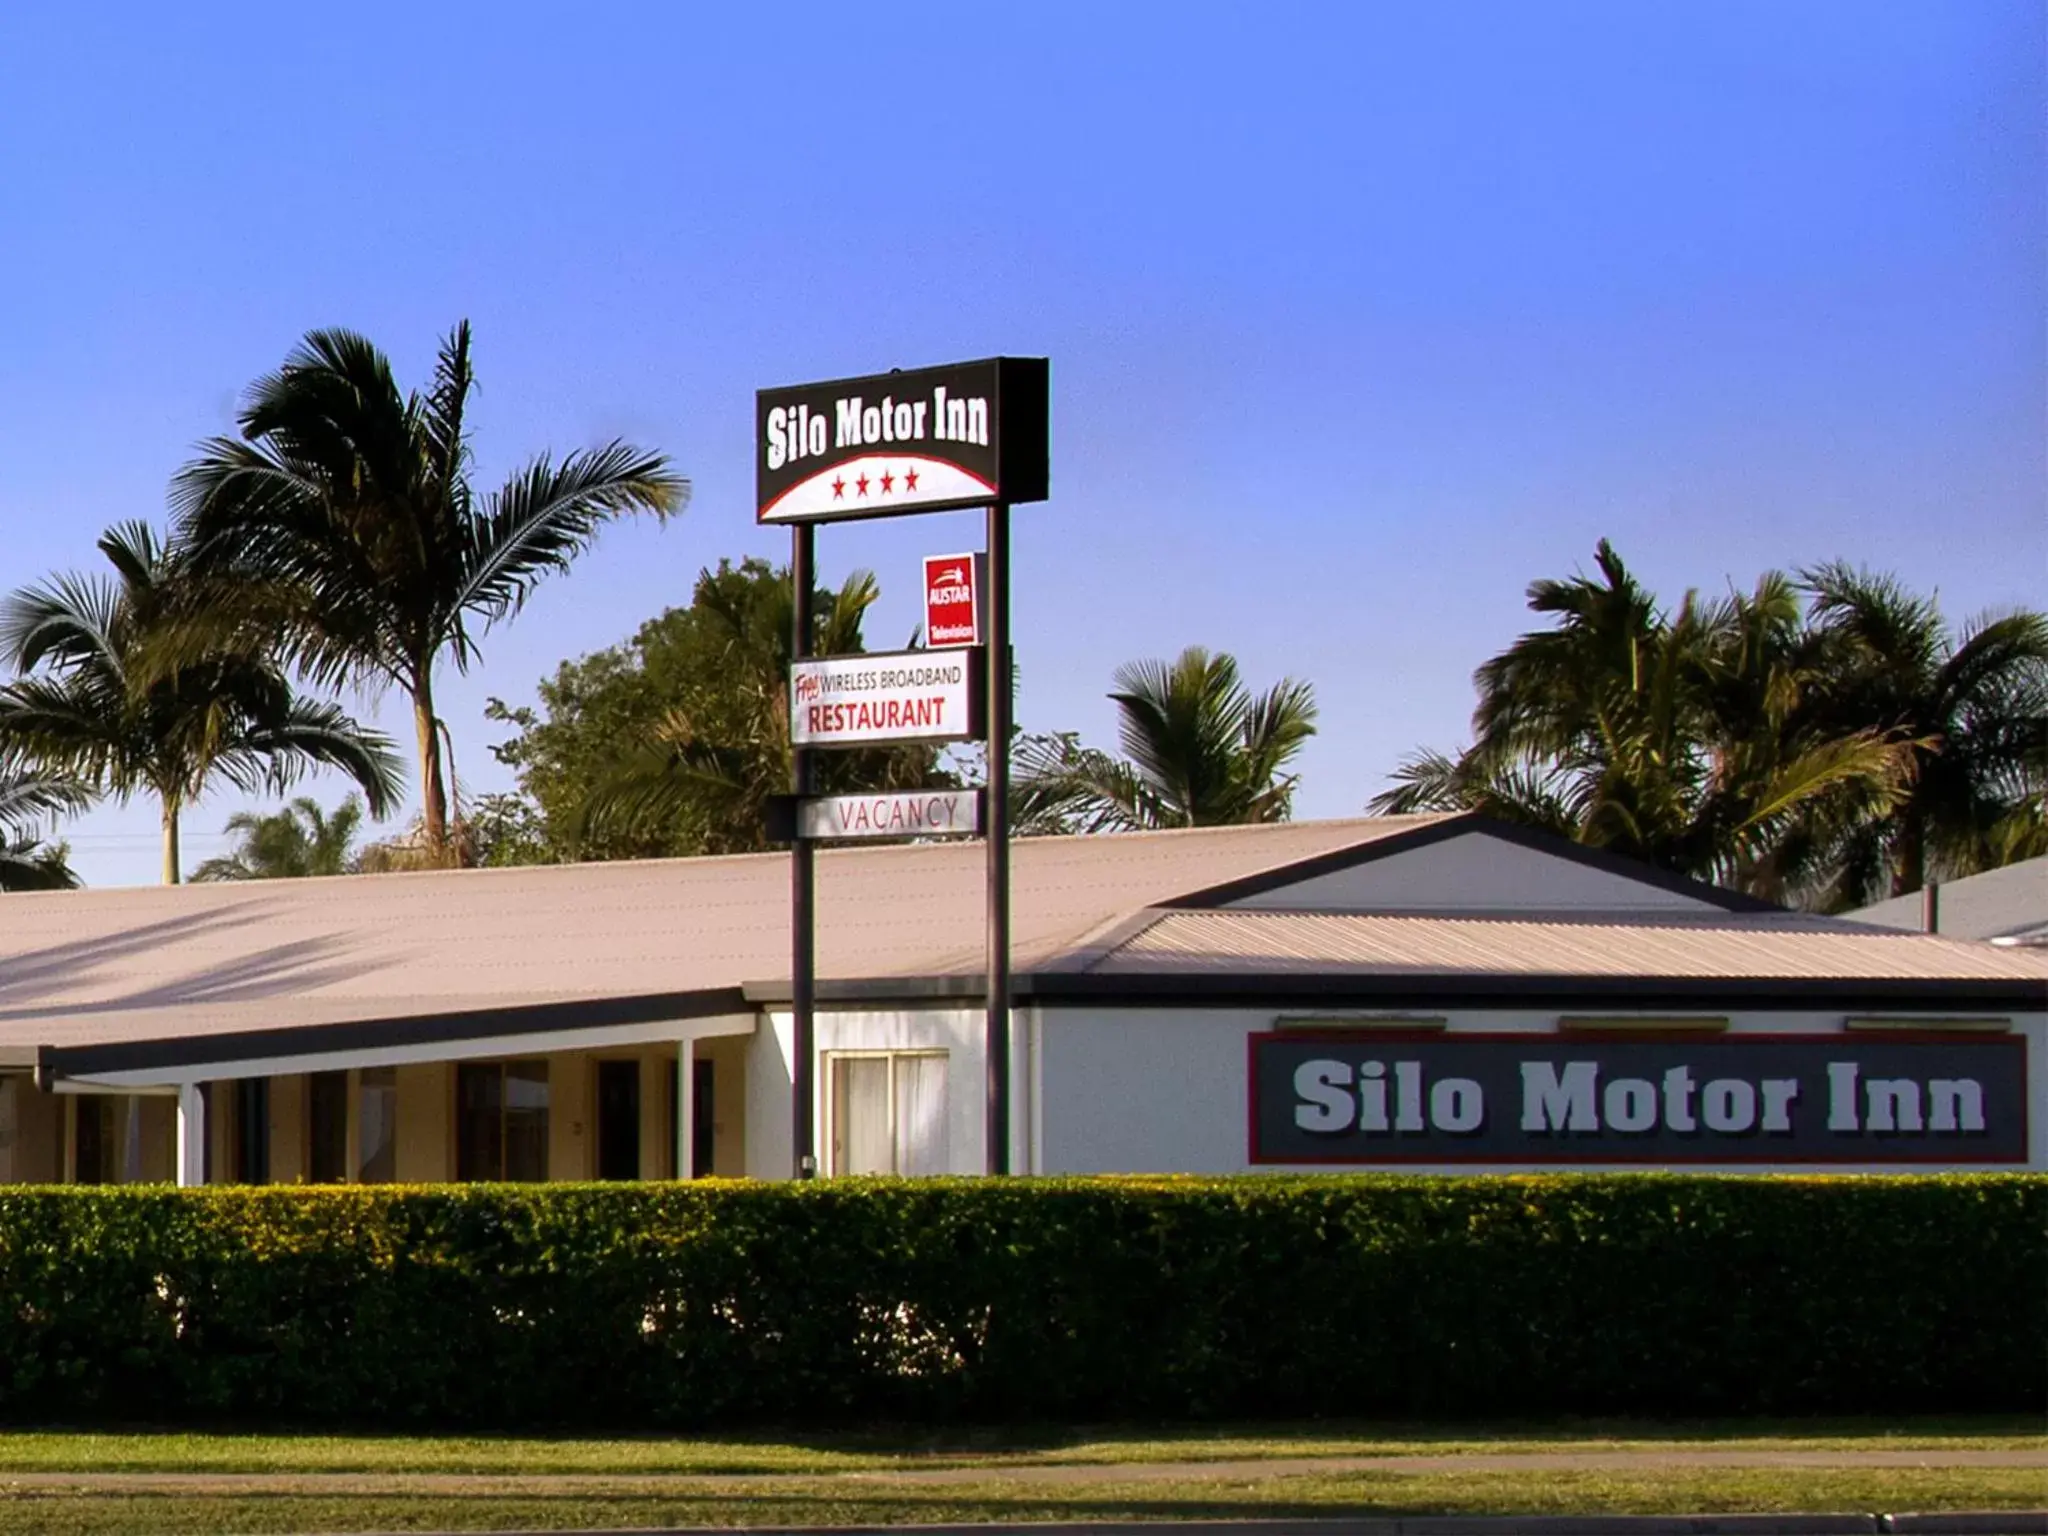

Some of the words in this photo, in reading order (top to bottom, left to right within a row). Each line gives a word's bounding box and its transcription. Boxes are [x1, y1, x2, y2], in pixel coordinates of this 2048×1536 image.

[767, 404, 827, 470] Silo
[835, 396, 927, 448] Motor
[934, 386, 988, 446] Inn
[929, 585, 970, 605] AUSTAR
[795, 671, 821, 704] Free
[820, 671, 877, 693] WIRELESS
[881, 665, 961, 688] BROADBAND
[808, 697, 945, 733] RESTAURANT
[839, 797, 958, 829] VACANCY
[1293, 1060, 1484, 1133] Silo
[1520, 1060, 1799, 1133] Motor
[1827, 1061, 1987, 1133] Inn
